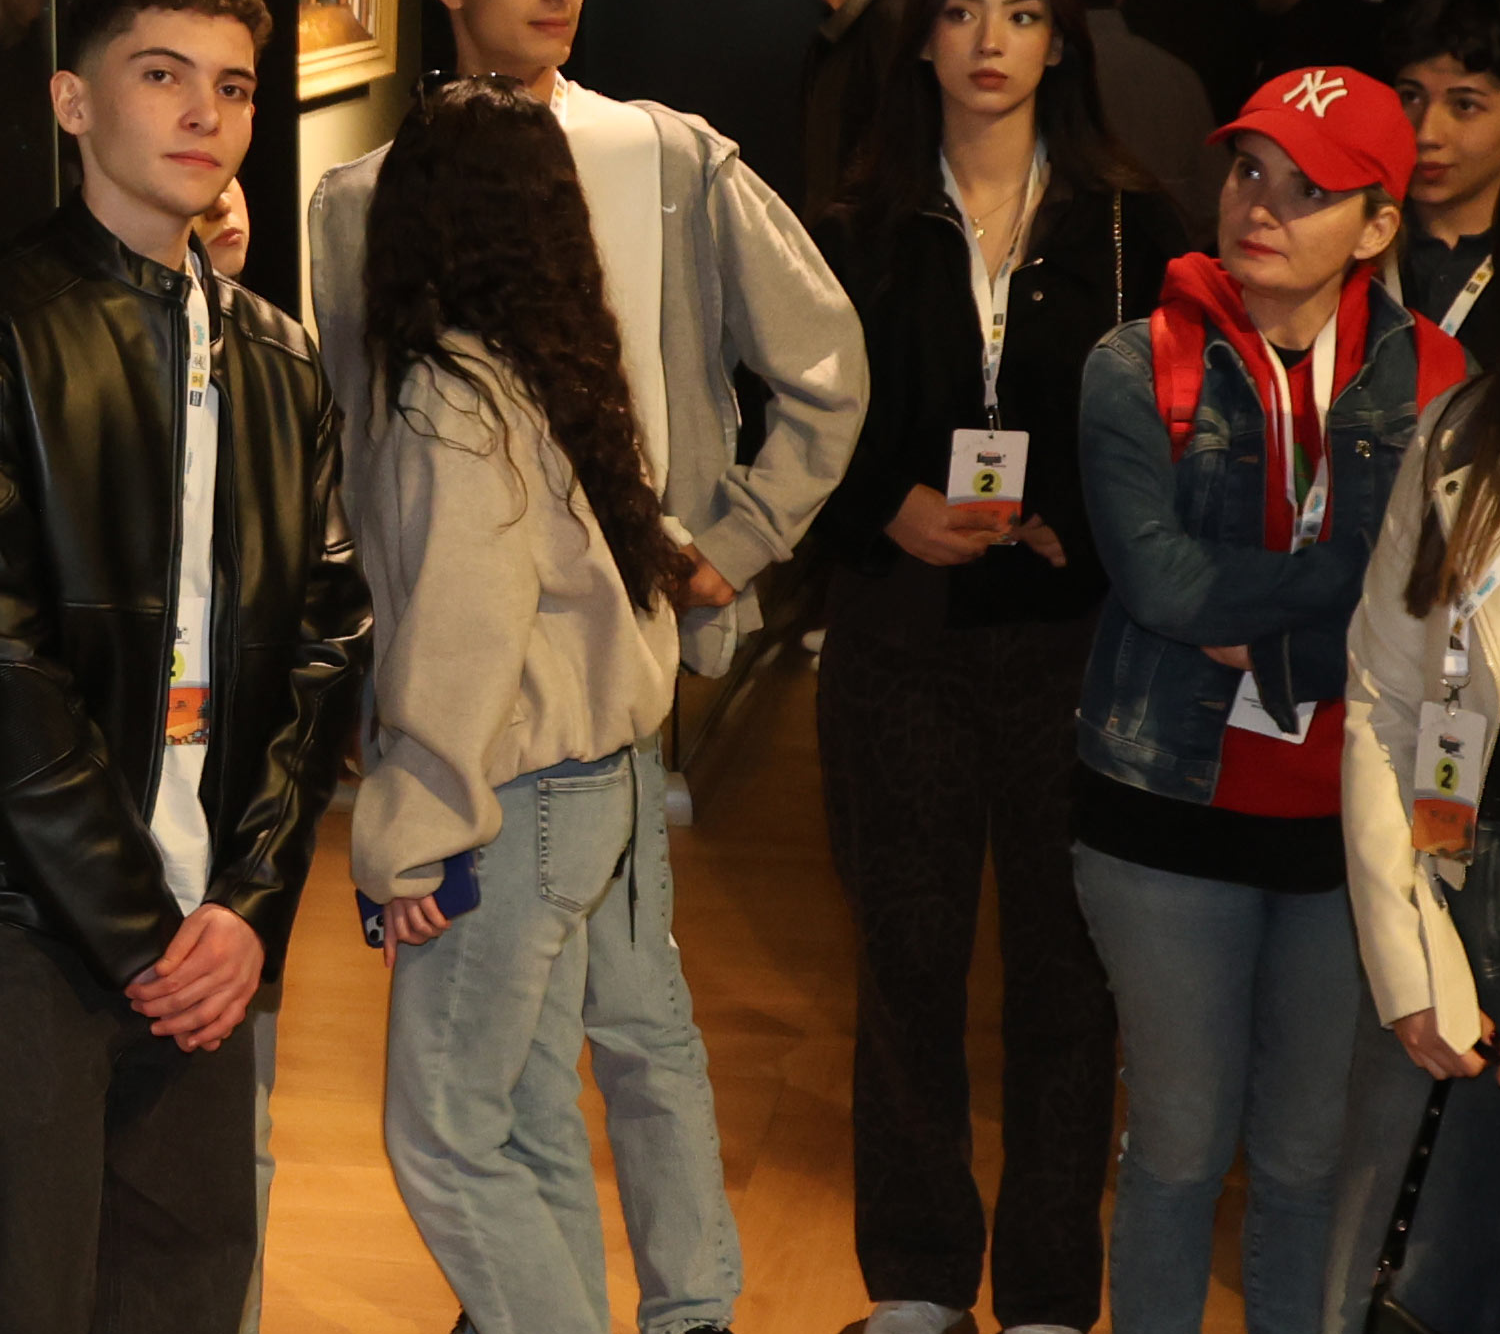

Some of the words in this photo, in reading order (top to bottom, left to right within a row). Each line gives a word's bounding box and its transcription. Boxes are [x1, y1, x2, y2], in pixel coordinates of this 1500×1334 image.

[1282, 69, 1348, 118] NY
[981, 473, 995, 492] 2
[1441, 763, 1454, 789] 2
